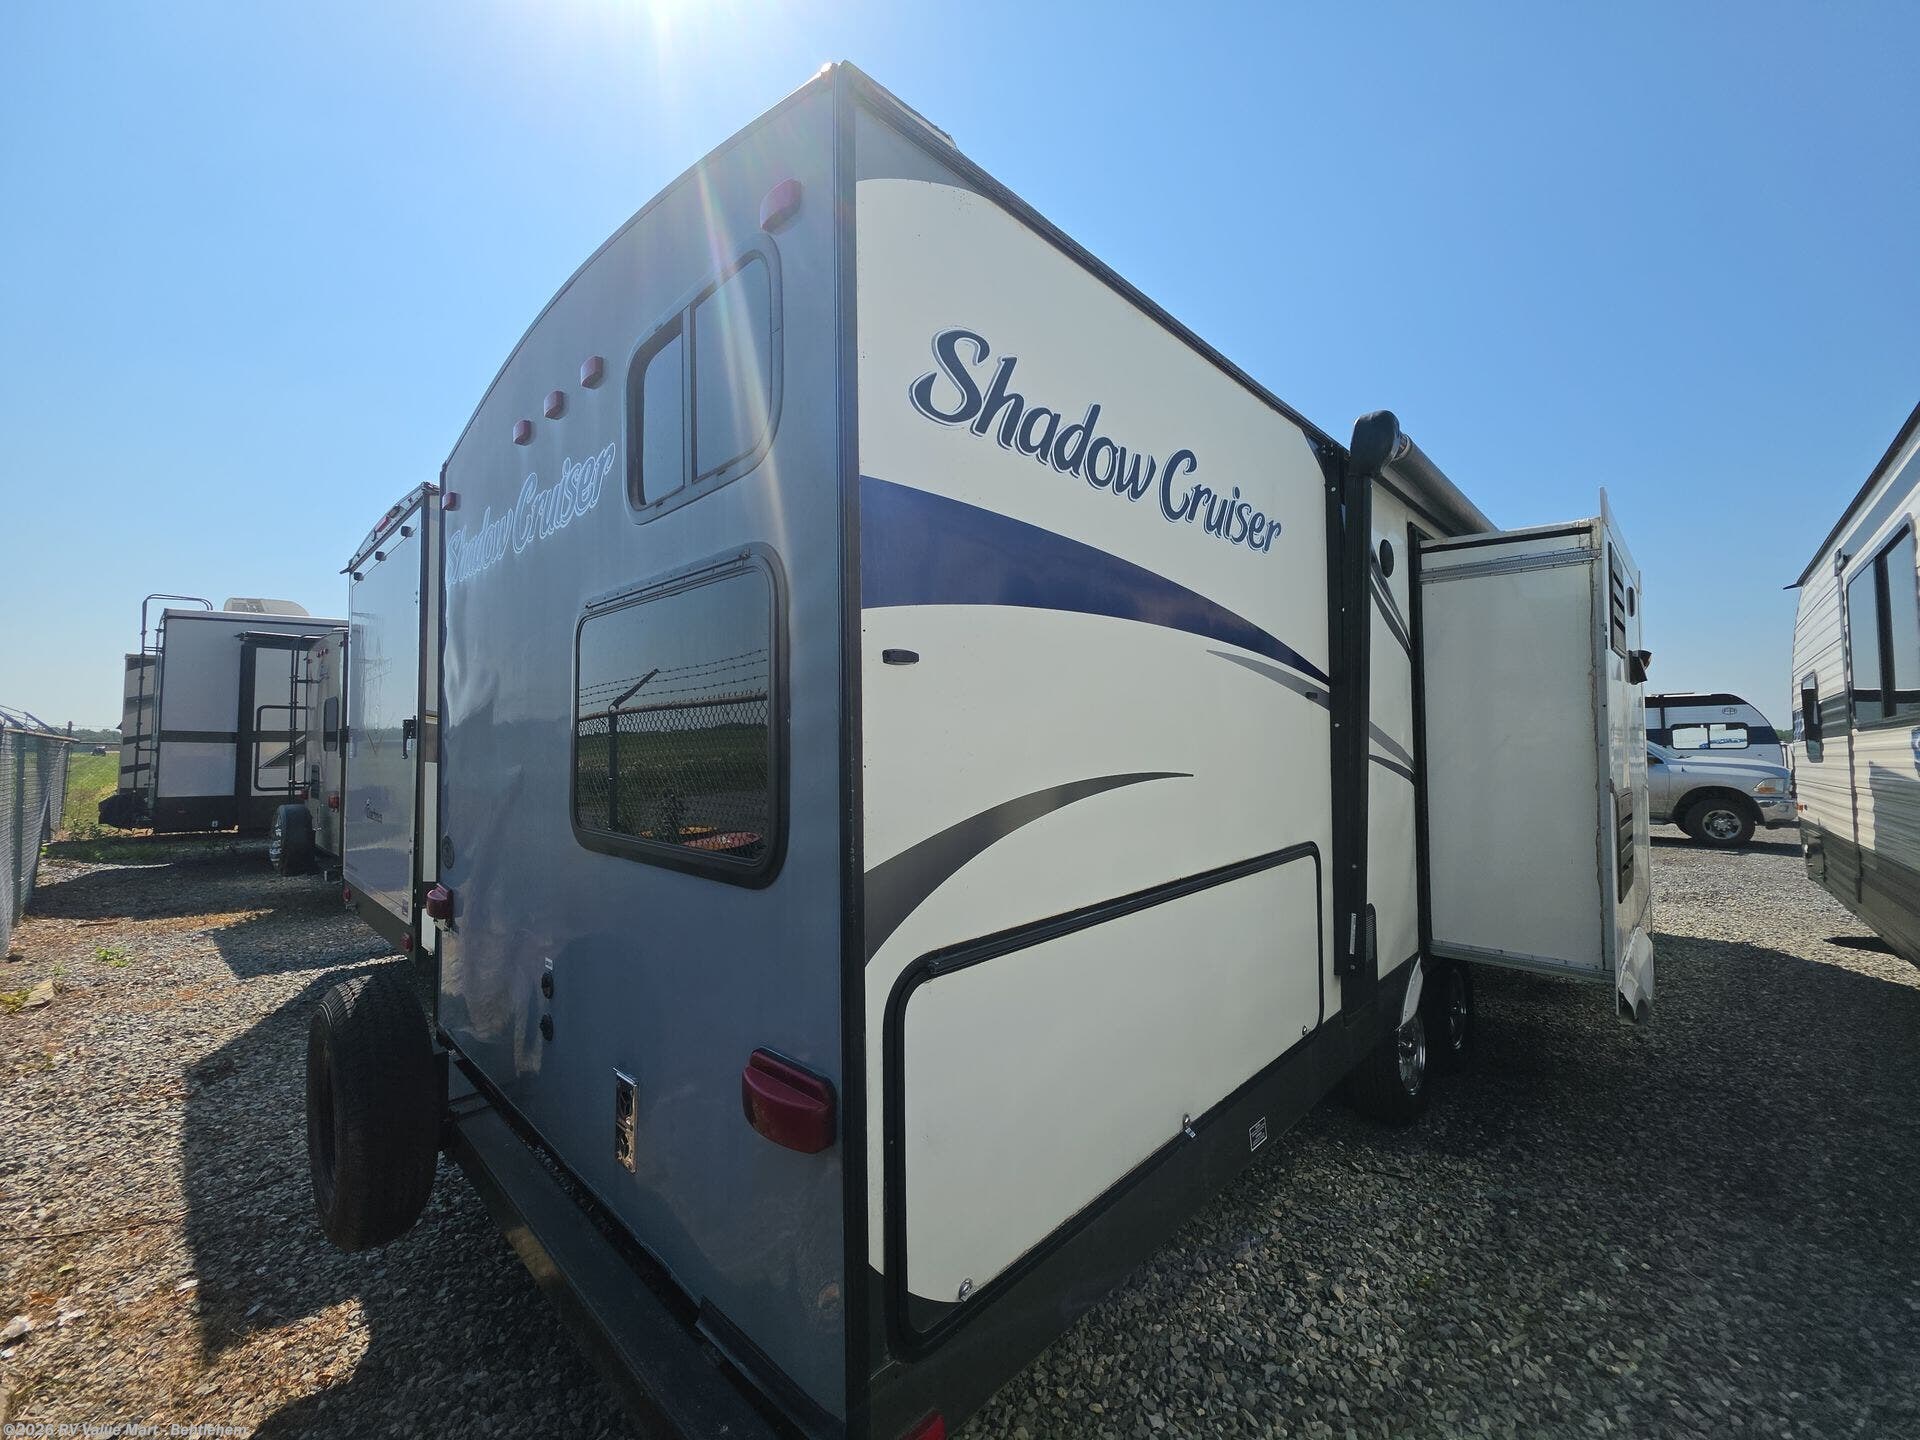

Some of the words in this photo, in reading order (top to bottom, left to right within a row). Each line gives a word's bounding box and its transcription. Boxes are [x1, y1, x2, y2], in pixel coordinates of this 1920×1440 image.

[512, 442, 616, 554] Cruiser
[908, 326, 1157, 503] Shadow
[1158, 448, 1282, 556] Cruiser
